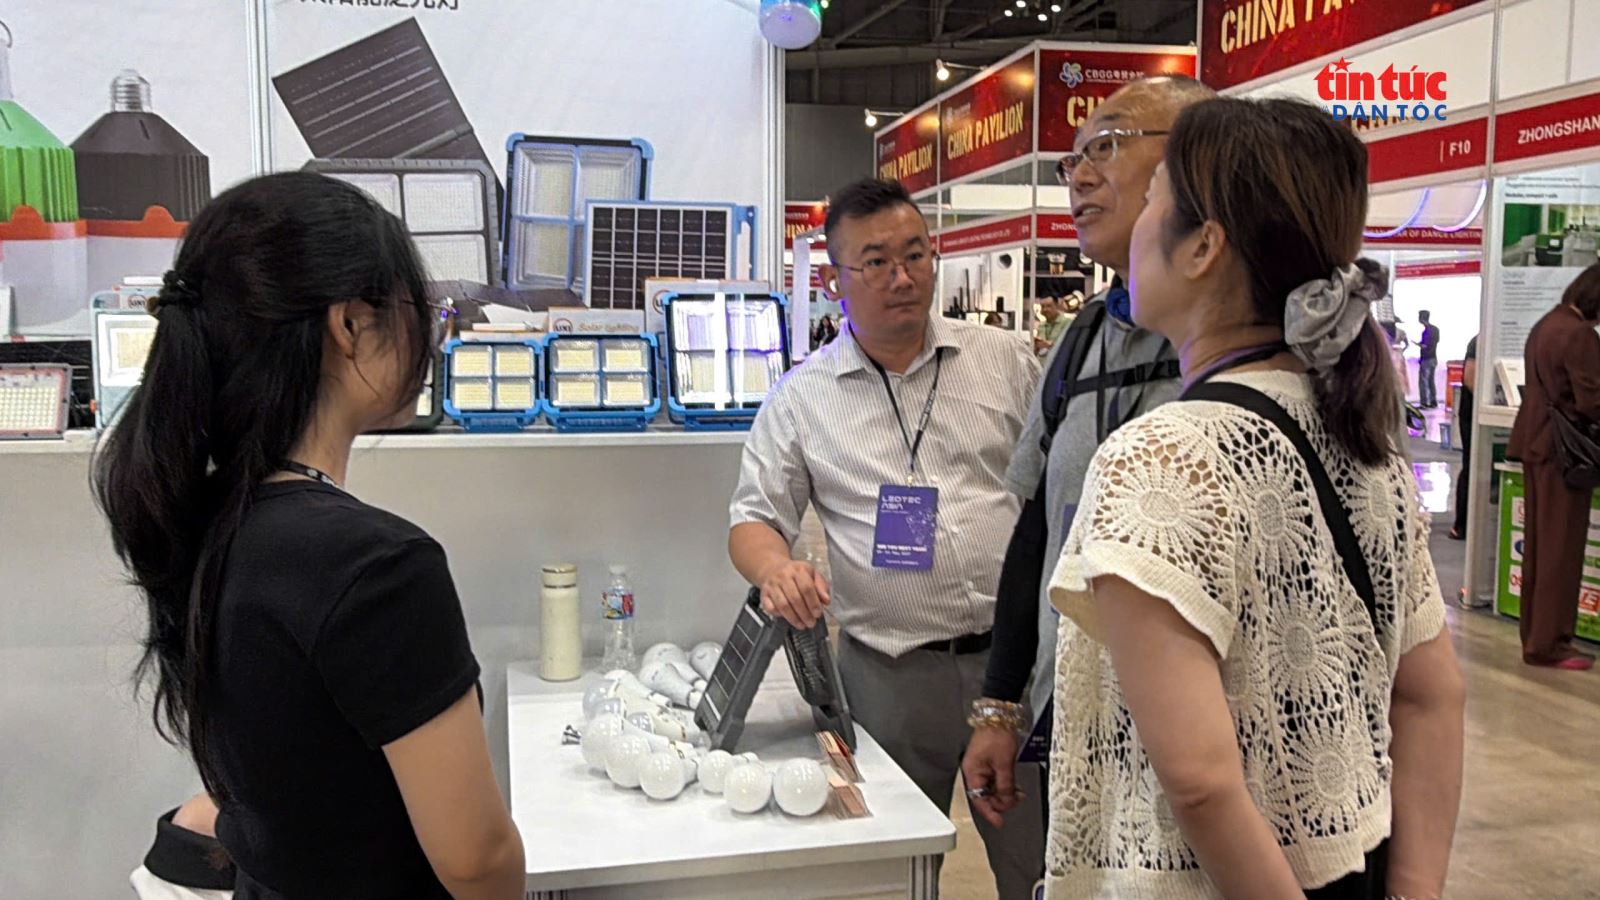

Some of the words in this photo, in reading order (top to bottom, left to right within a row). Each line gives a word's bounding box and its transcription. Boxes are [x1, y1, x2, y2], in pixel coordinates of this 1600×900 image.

[947, 124, 974, 160] CHINA
[975, 101, 1025, 149] PAVILION
[1517, 114, 1600, 145] ZHONGSHAN
[898, 143, 933, 178] PAVILION
[1449, 139, 1471, 157] F10
